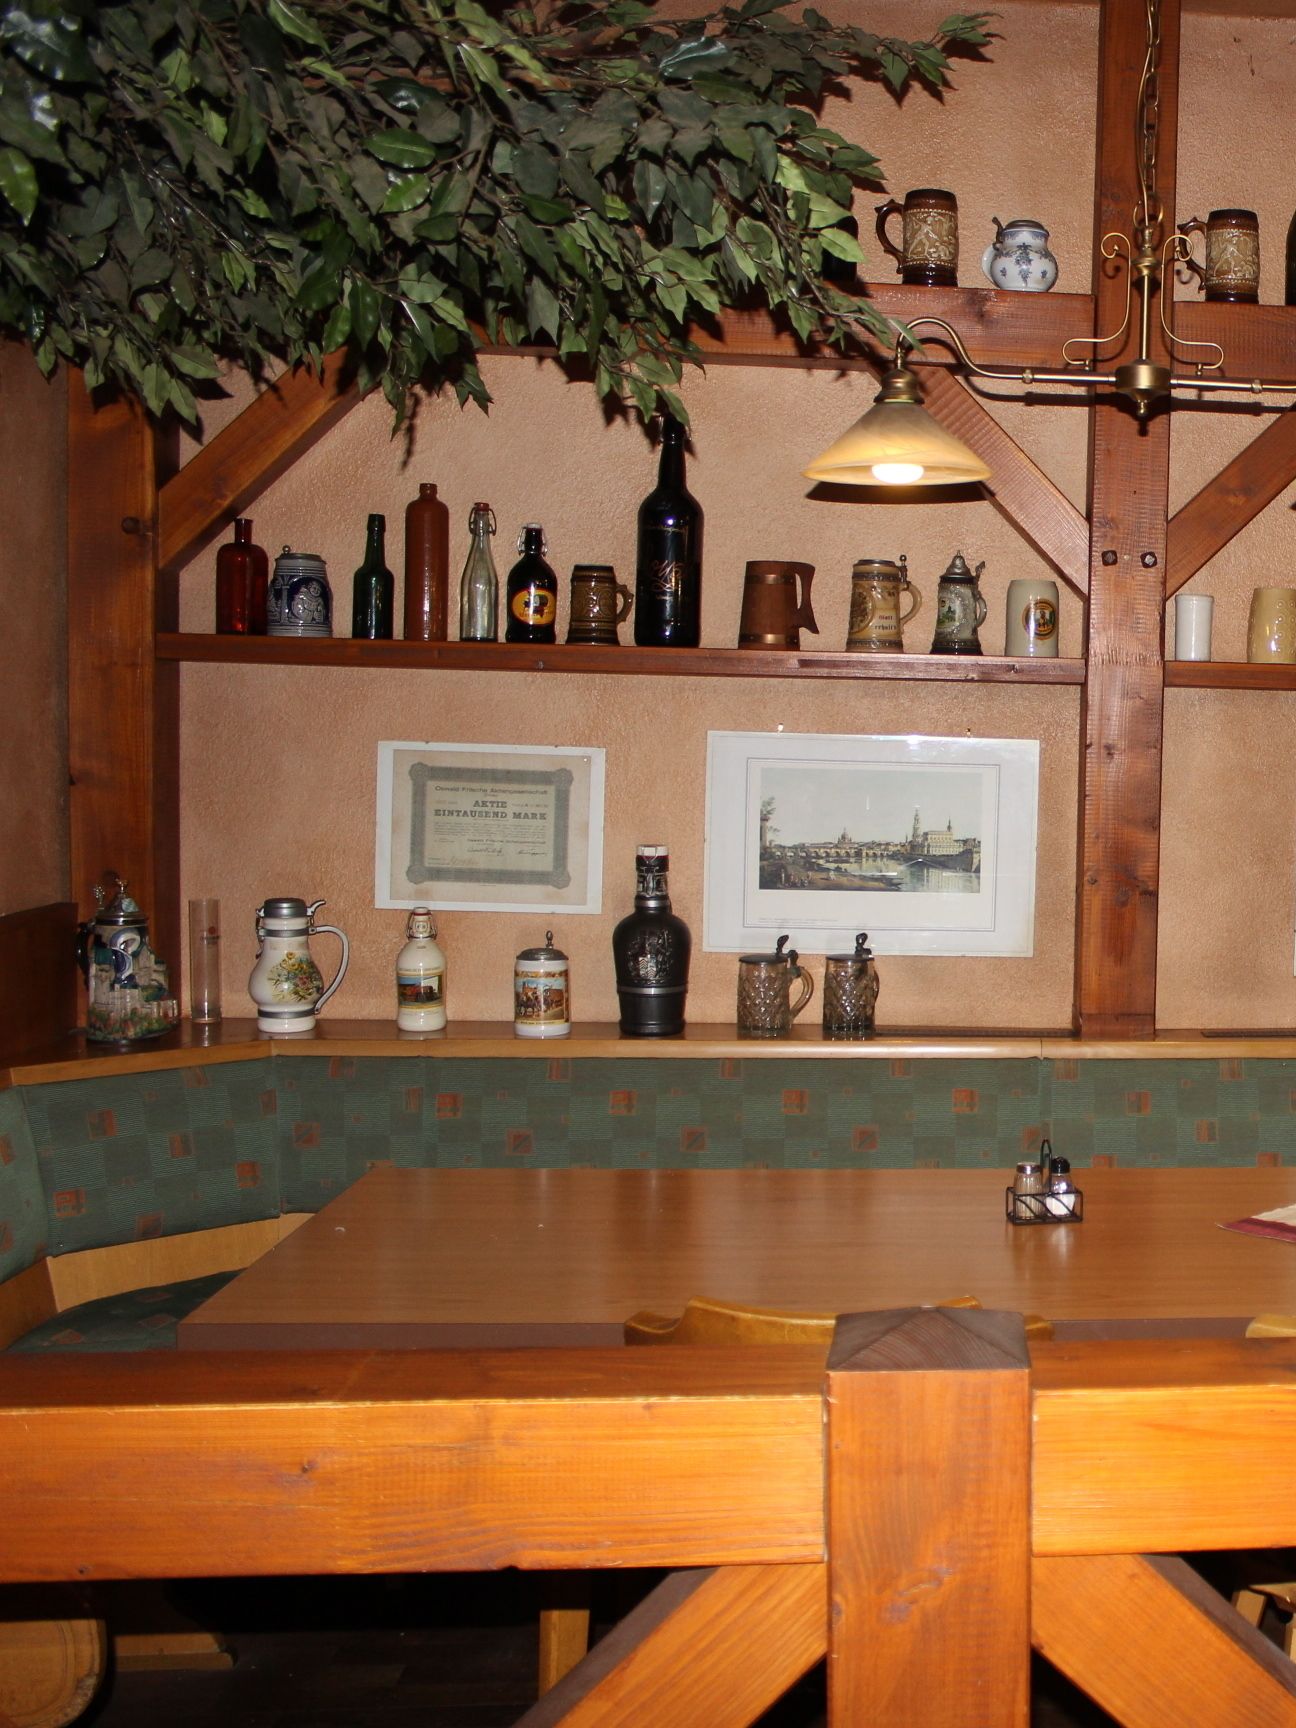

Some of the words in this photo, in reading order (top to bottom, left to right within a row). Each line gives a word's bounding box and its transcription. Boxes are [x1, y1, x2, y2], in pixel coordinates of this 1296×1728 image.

[473, 800, 507, 809] AKTIE
[434, 809, 508, 819] EINTAUSEND
[512, 812, 547, 820] MARK
